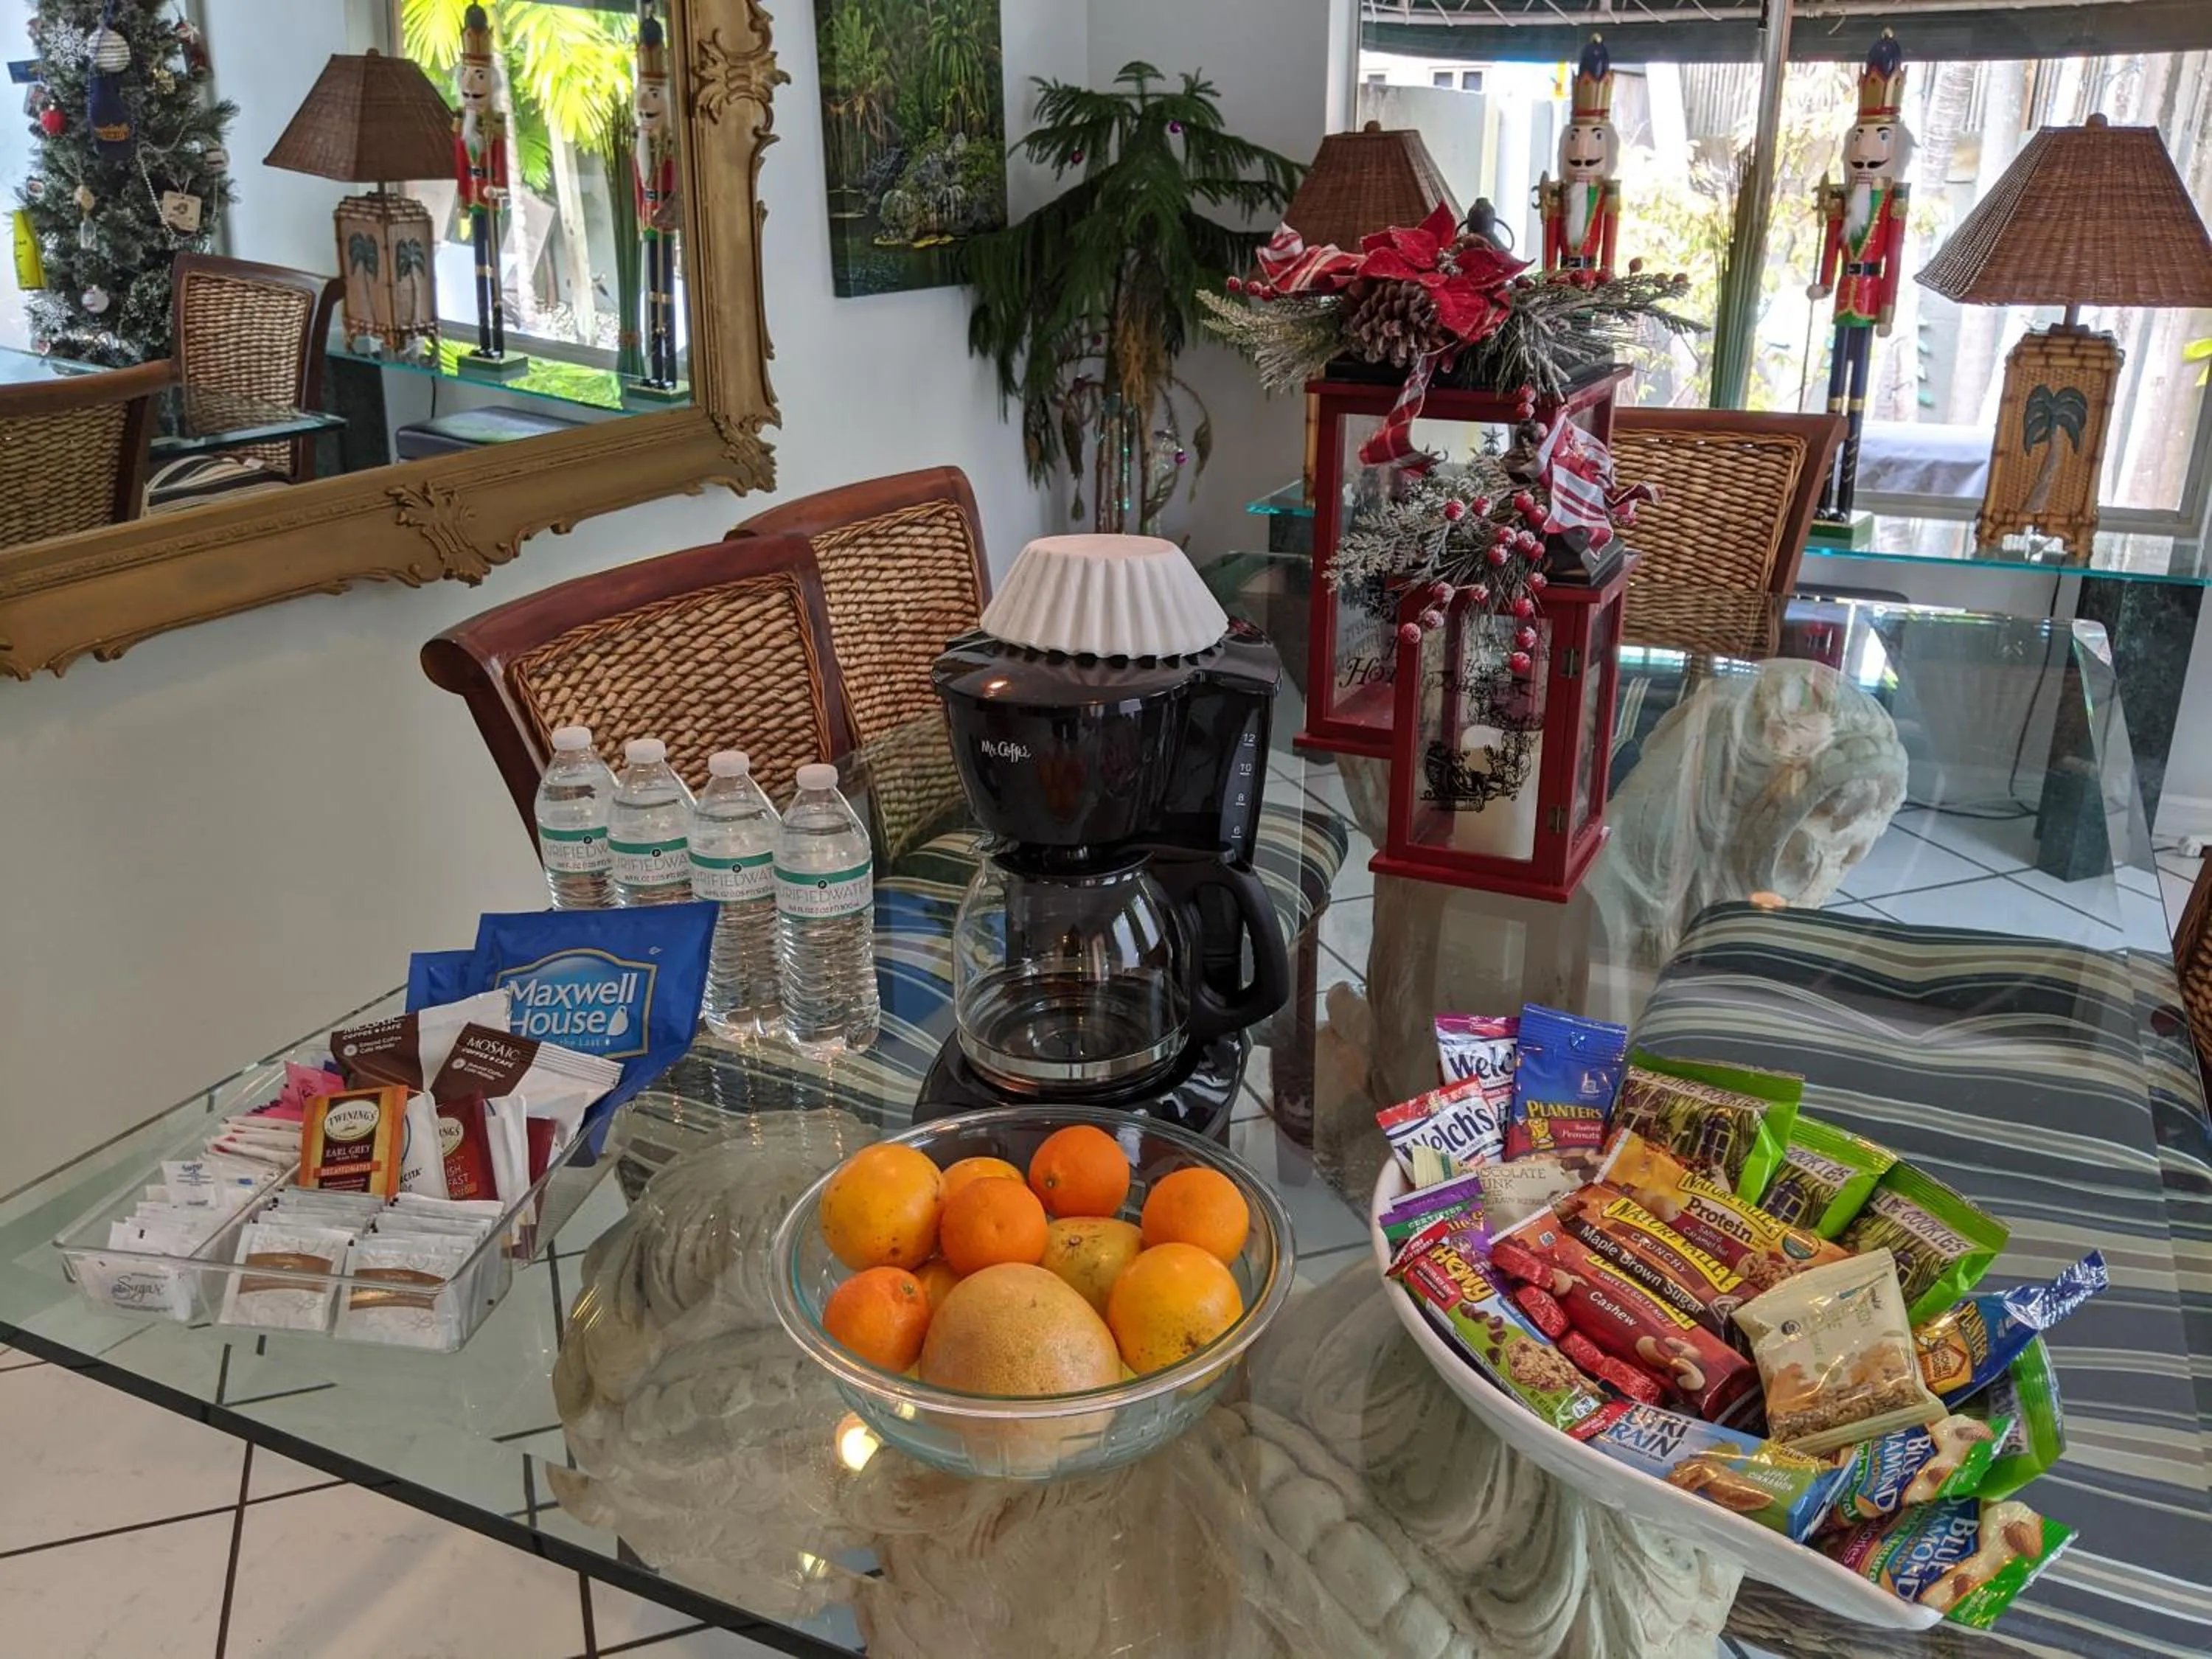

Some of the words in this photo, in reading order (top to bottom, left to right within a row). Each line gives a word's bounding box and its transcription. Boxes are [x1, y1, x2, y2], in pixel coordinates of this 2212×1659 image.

[1243, 733, 1255, 743] 12
[1240, 762, 1252, 772] 10
[508, 973, 639, 1009] Maxwell
[466, 1037, 521, 1062] MOSAIC
[1526, 1099, 1604, 1119] PLANTERS
[324, 1146, 347, 1159] EARL
[349, 1144, 372, 1155] GREY
[1482, 1179, 1514, 1189] UNK
[1683, 1195, 1753, 1244] Protein
[1630, 1231, 1688, 1273] CRUNCHY
[1580, 1225, 1618, 1256] Maple
[1619, 1249, 1662, 1287] Brown
[1663, 1281, 1705, 1315] Sugar
[1589, 1290, 1638, 1328] Cashew
[1607, 1423, 1682, 1457] RAIN
[1923, 1516, 1980, 1575] BLUE
